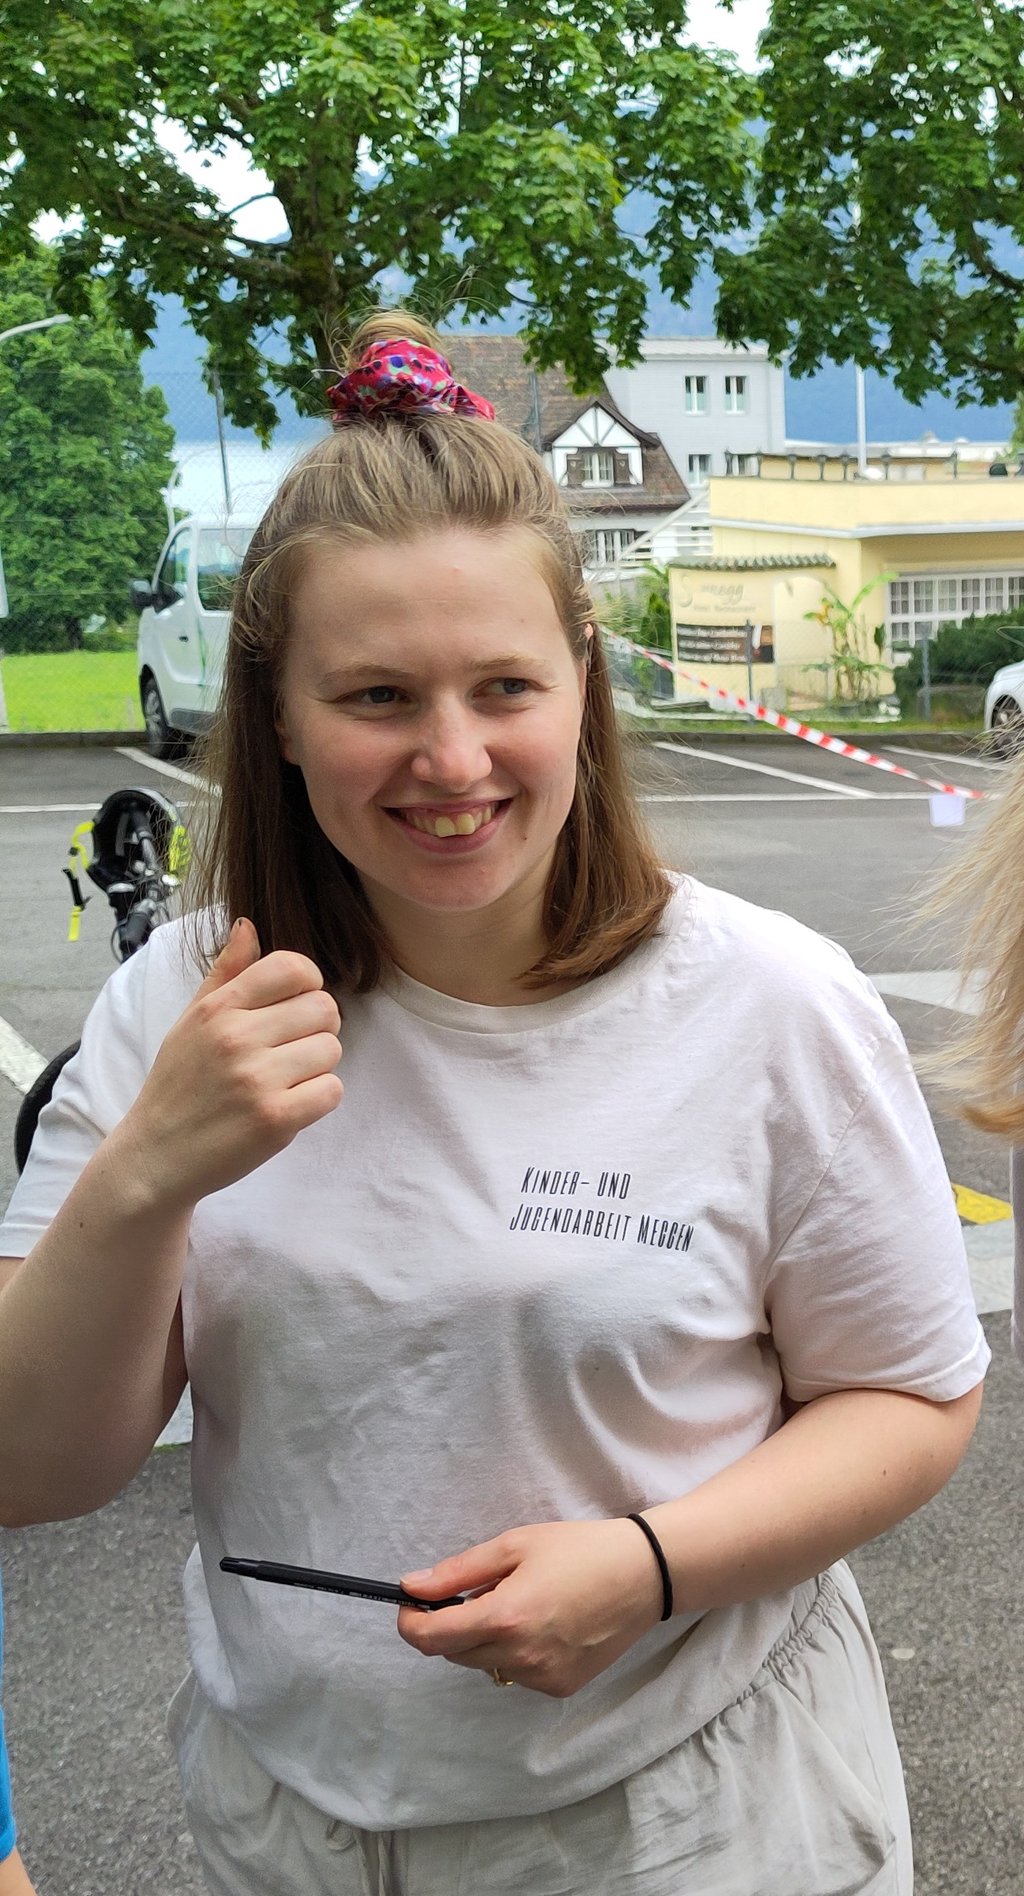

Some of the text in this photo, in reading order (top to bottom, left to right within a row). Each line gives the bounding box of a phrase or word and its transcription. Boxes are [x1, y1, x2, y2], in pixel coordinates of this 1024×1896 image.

[521, 1167, 631, 1199] KINDER- UND
[509, 1203, 694, 1252] JUGENDARBEIT MEGGEN
